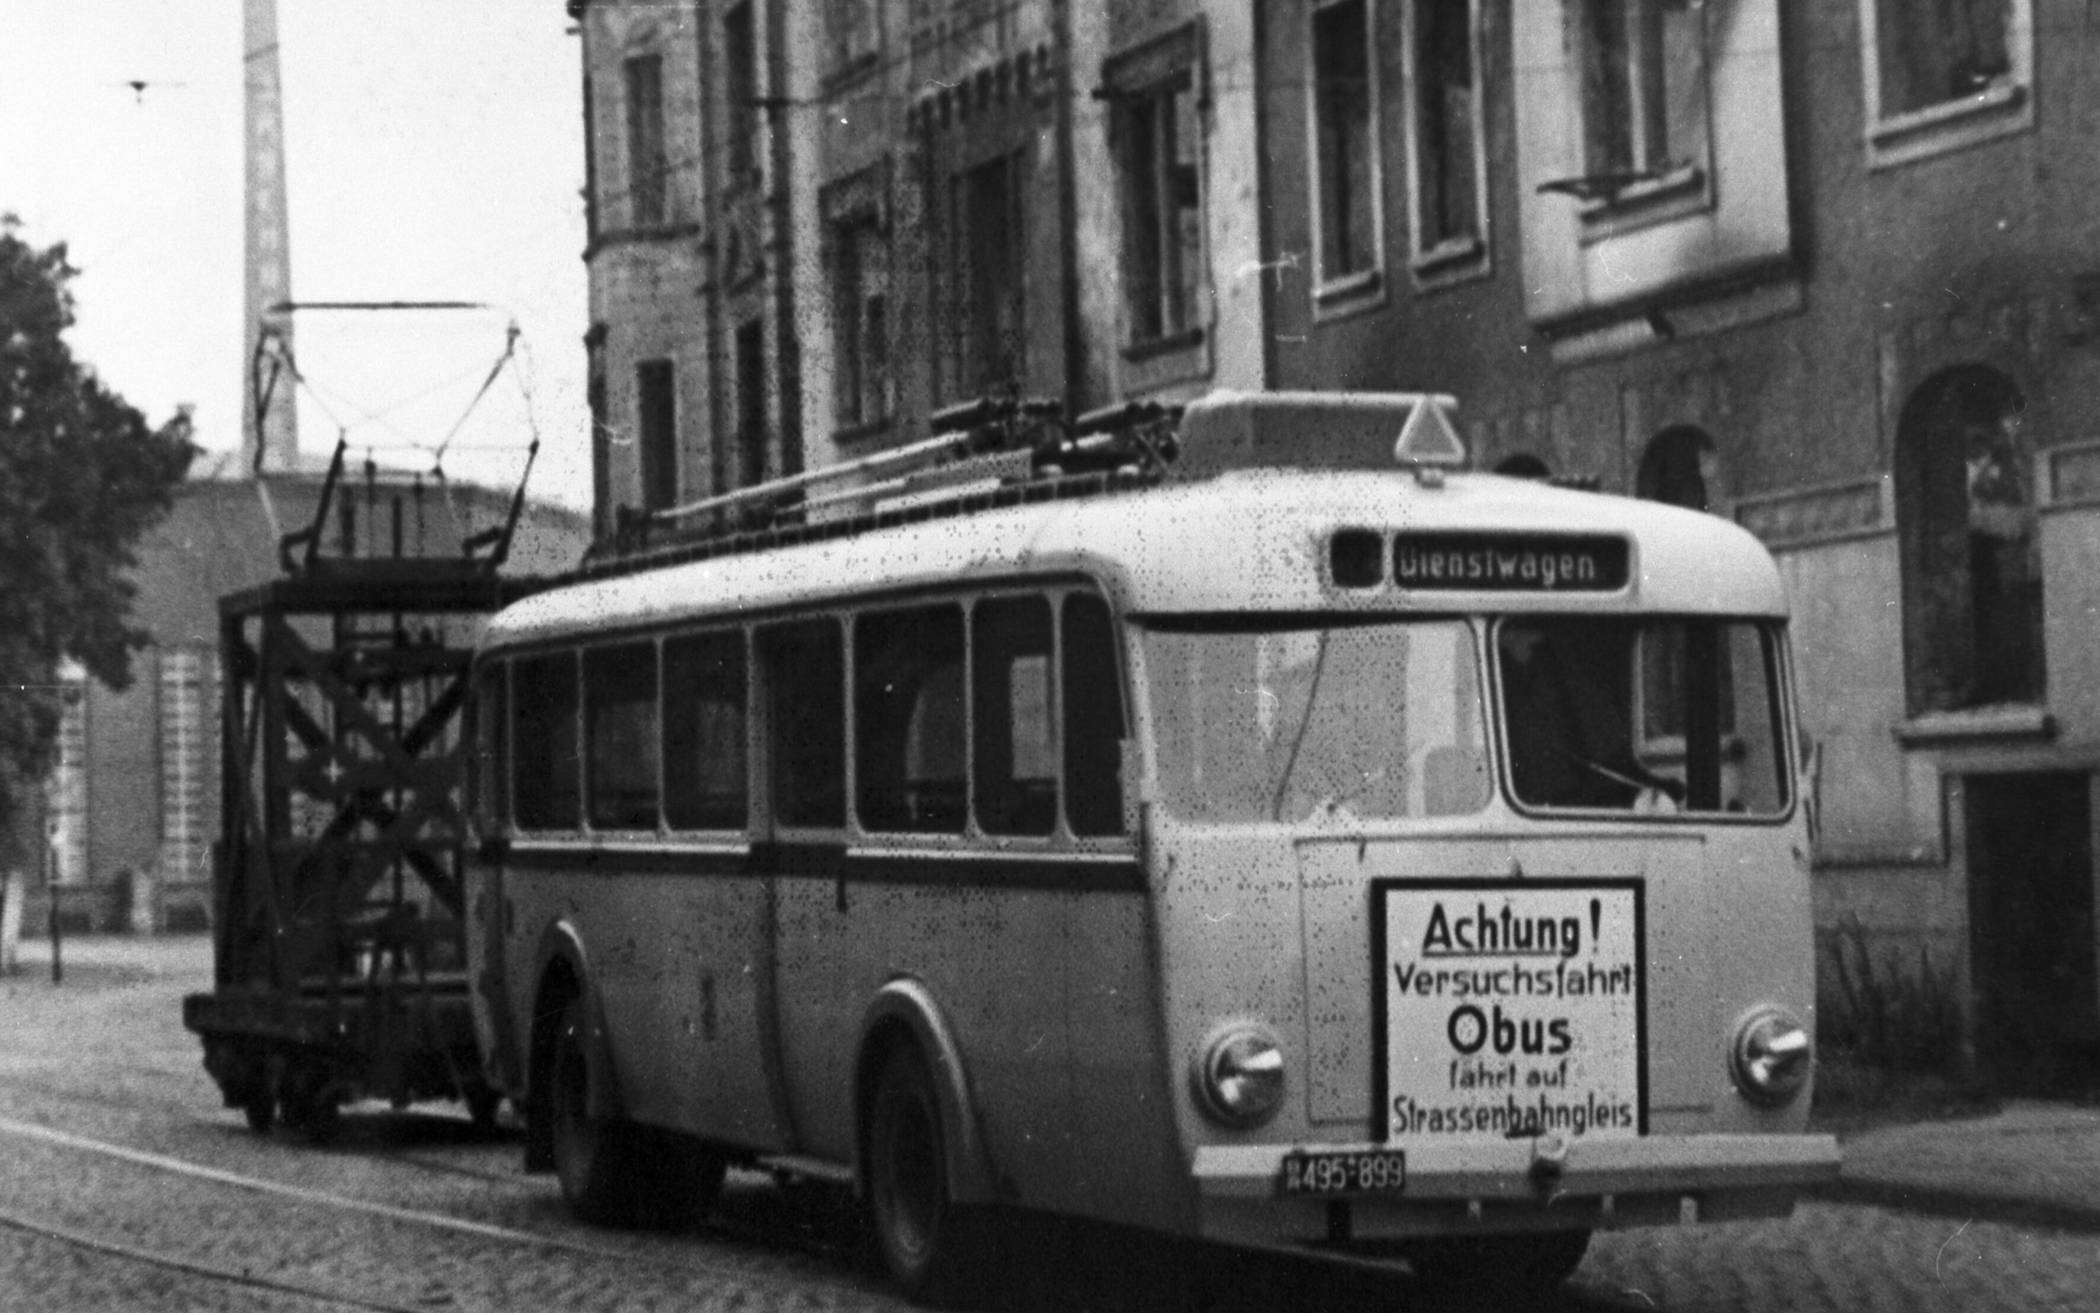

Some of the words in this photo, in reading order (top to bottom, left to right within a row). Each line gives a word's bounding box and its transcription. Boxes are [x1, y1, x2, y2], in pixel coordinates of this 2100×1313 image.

[1400, 550, 1596, 586] Dienstwagen
[1393, 962, 1632, 998] Versuchsfahrt
[1447, 1004, 1572, 1055] Obus
[1526, 1057, 1567, 1089] auf
[1393, 1091, 1632, 1136] Strassenbahngleis
